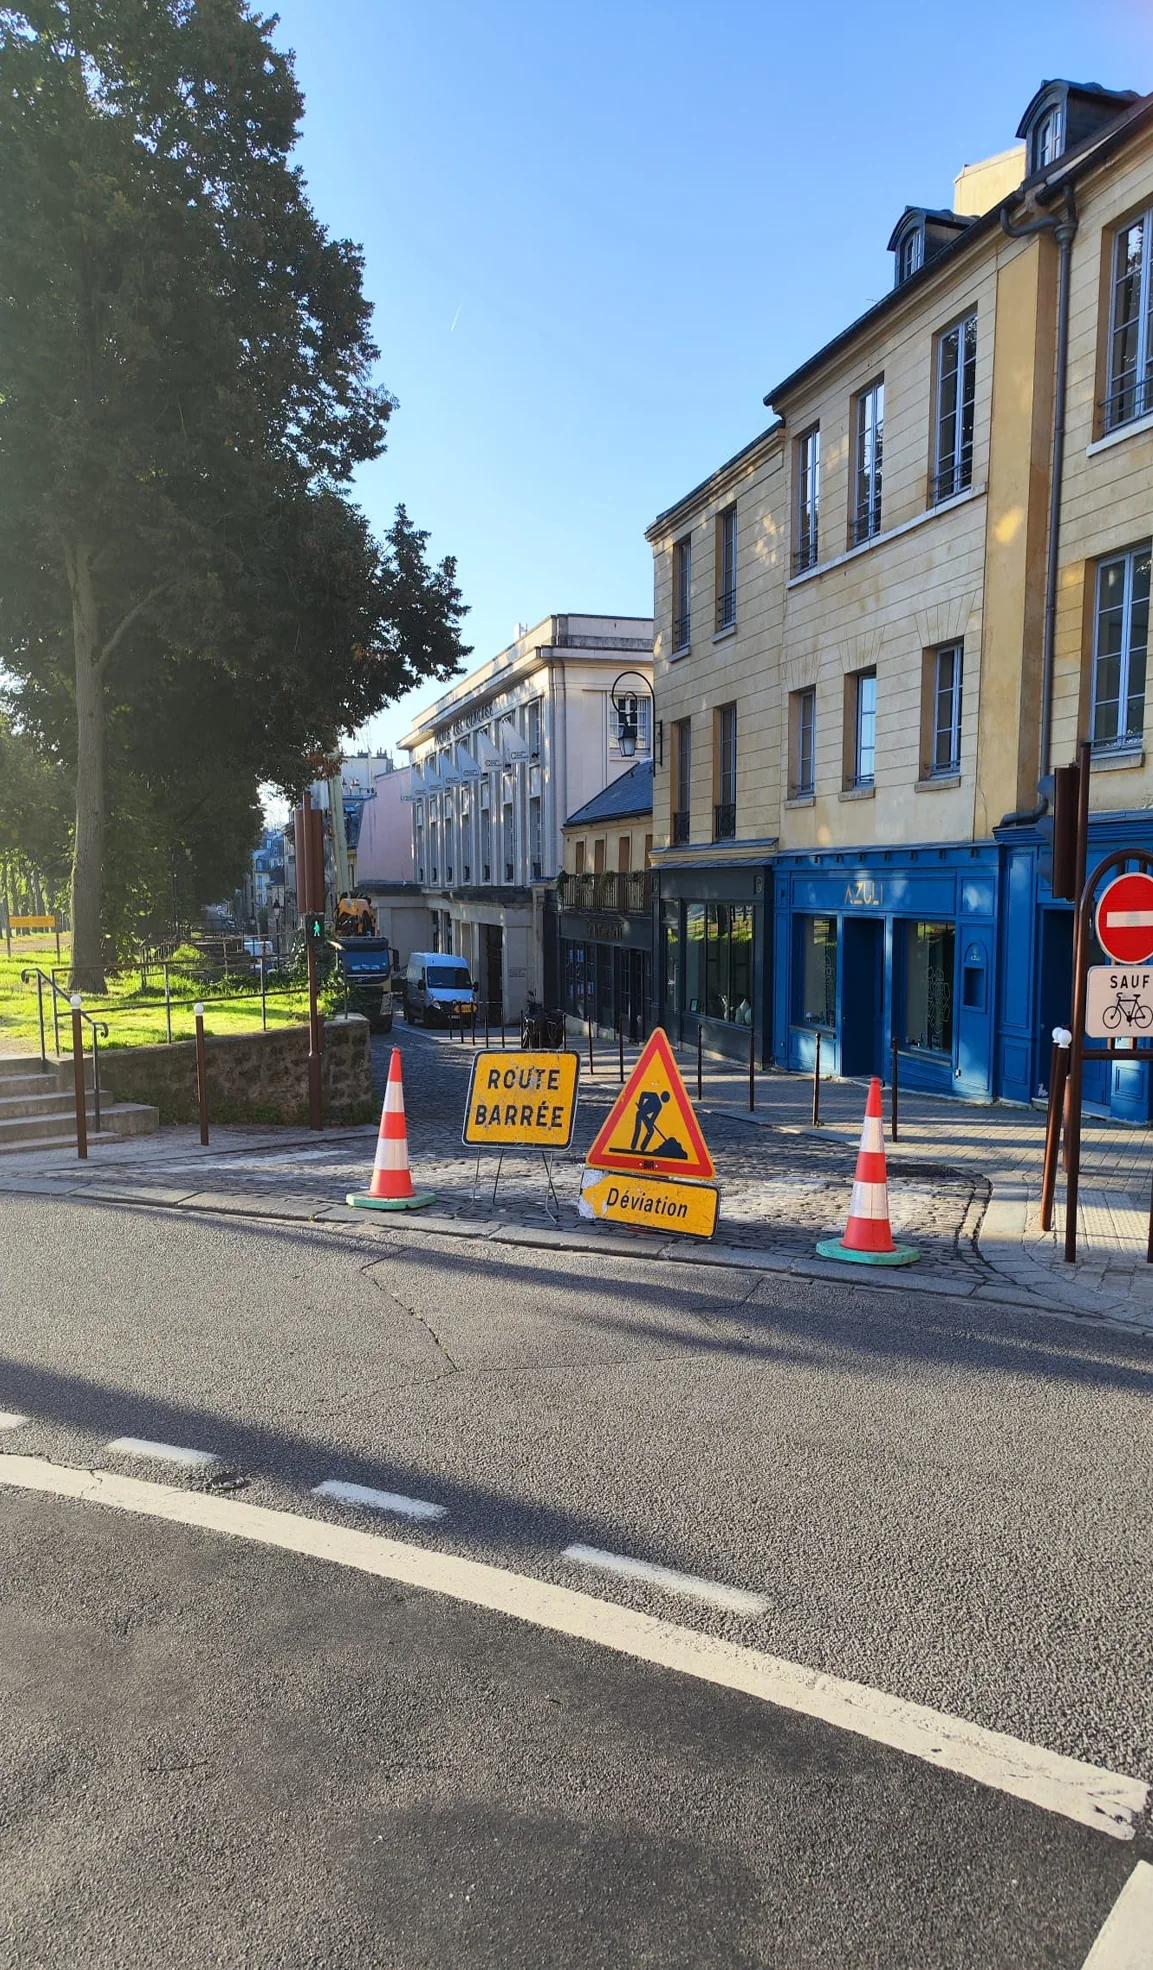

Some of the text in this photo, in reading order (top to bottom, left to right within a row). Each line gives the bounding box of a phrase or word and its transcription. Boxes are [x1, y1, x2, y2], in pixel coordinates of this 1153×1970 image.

[1109, 974, 1150, 989] SAUF
[487, 1068, 561, 1091] ROUTE
[475, 1101, 564, 1128] BARRÉE
[606, 1187, 688, 1218] Déviation
